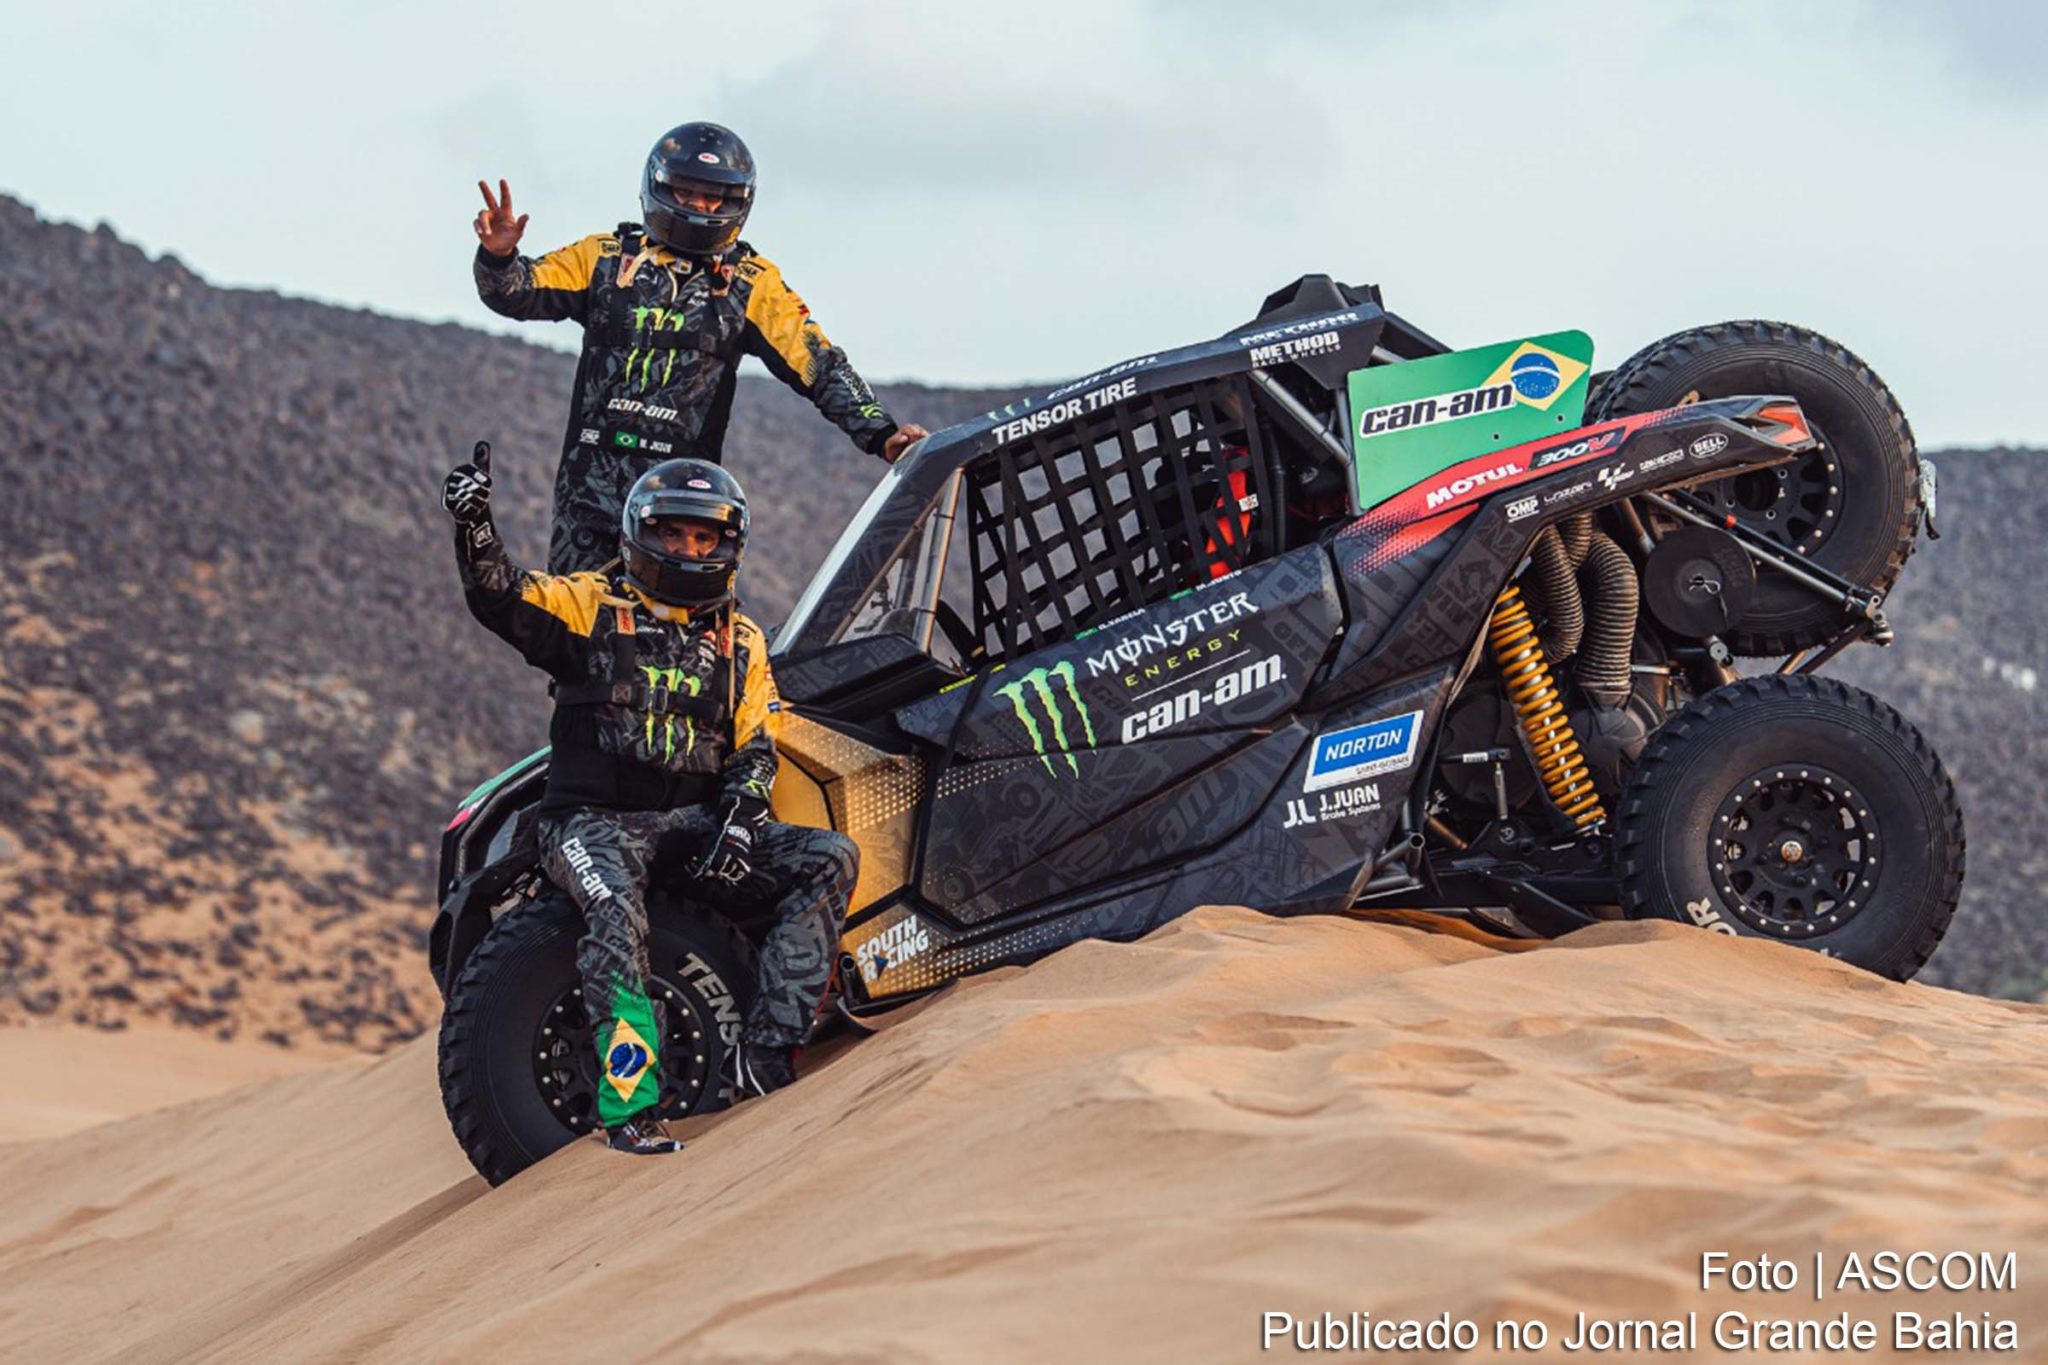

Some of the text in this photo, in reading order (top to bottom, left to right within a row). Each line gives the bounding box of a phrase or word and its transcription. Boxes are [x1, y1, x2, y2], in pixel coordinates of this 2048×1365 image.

[1249, 331, 1340, 361] METHOD
[1290, 343, 1342, 361] WHEELS
[991, 377, 1137, 446] TENSOR TIRE
[1361, 383, 1514, 435] can-am
[1537, 432, 1616, 467] 300V
[1694, 436, 1725, 453] BELL
[1426, 463, 1523, 509] MOTUL
[1507, 498, 1538, 518] OMP
[1085, 592, 1259, 678] MONSTER
[1124, 629, 1240, 688] ENERGY
[1121, 653, 1281, 745] can-am
[1325, 728, 1403, 762] NORTON
[1319, 783, 1380, 812] J.JUAN
[561, 837, 612, 901] can-am
[857, 914, 917, 967] SOUTH
